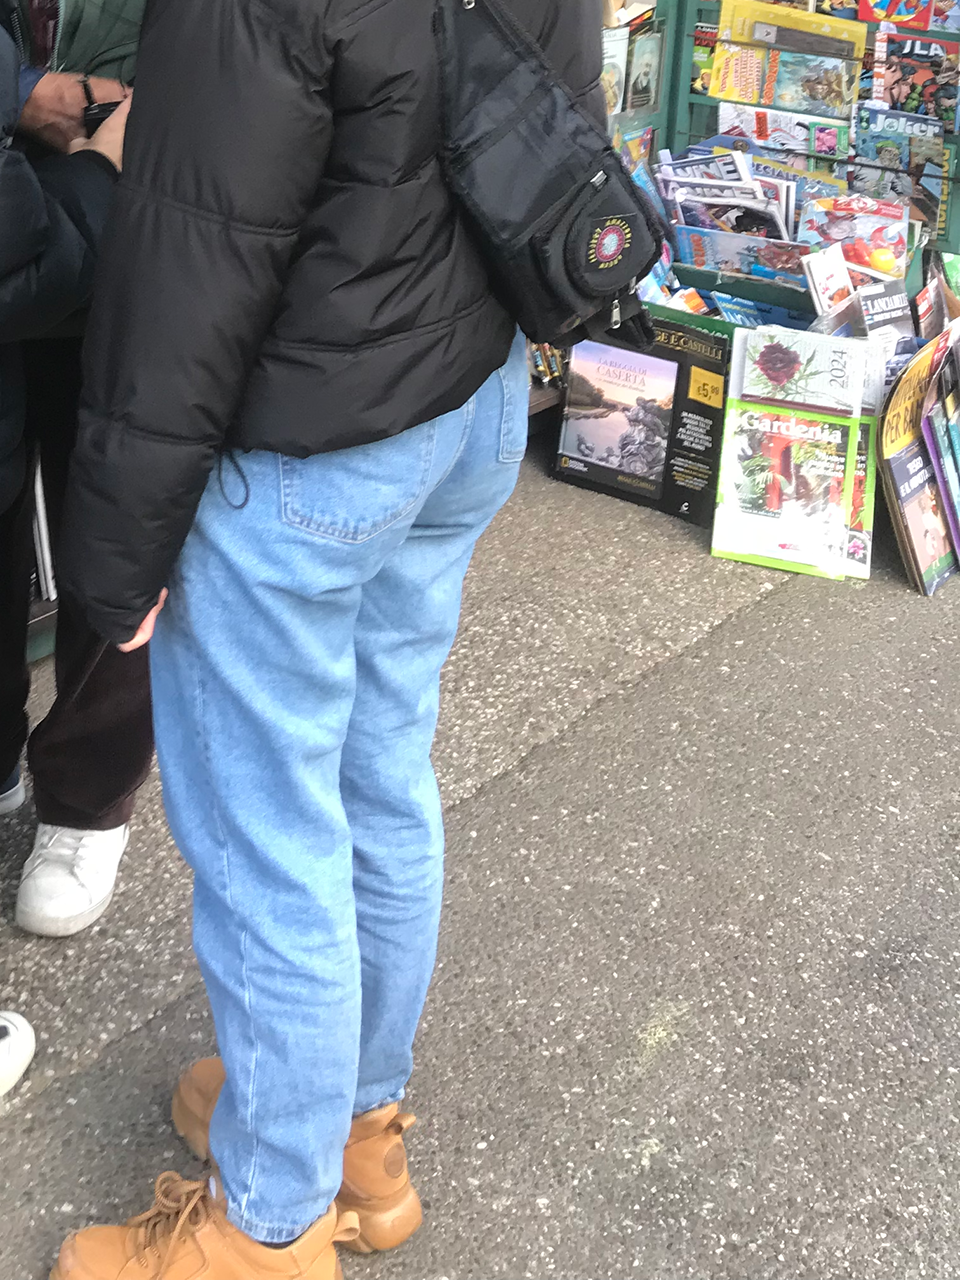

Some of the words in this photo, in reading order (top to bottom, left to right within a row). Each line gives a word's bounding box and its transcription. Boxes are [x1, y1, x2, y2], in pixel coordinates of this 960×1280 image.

[902, 39, 947, 57] JLA
[870, 112, 941, 137] Joker
[679, 335, 723, 361] CASTELLI
[597, 365, 647, 387] CASERTA
[830, 349, 848, 389] 2024
[741, 411, 842, 444] Gardenia
